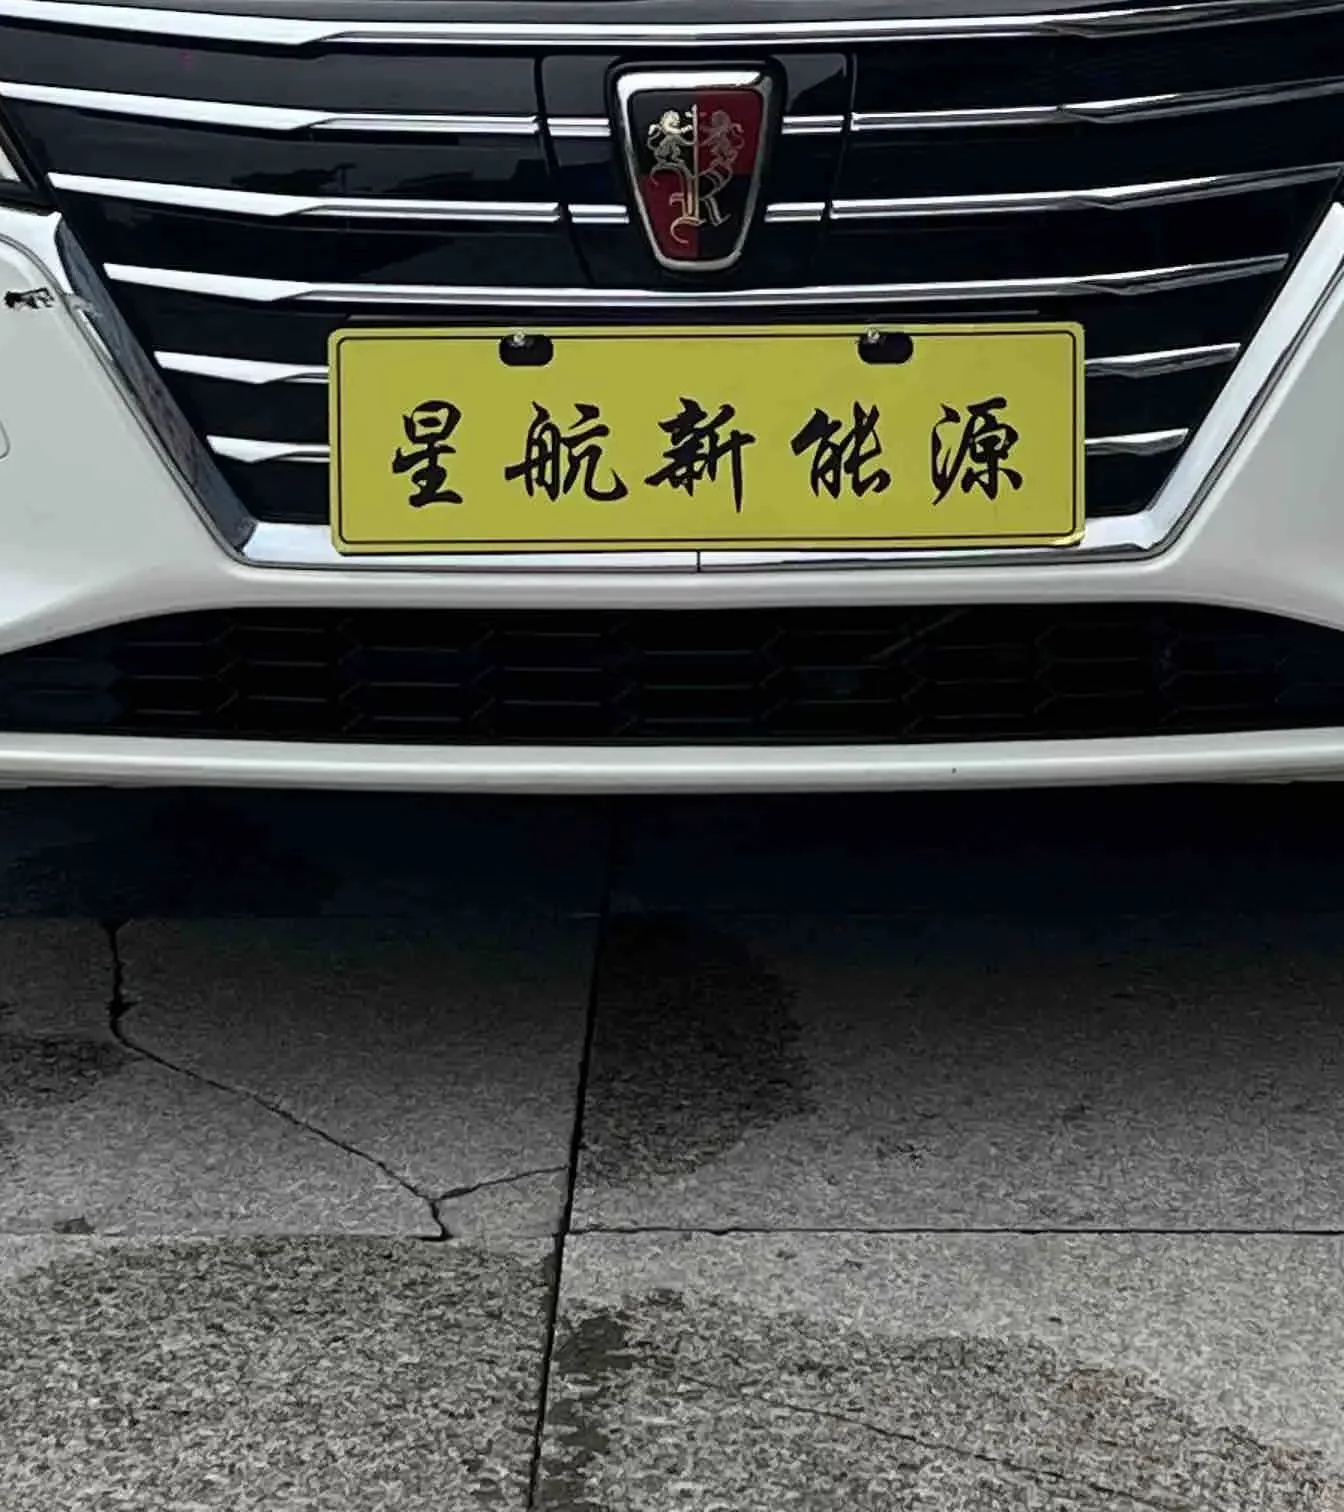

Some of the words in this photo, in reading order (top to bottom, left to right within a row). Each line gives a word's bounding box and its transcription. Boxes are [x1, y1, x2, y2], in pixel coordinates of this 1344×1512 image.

[390, 396, 1025, 514] 星航新能源
